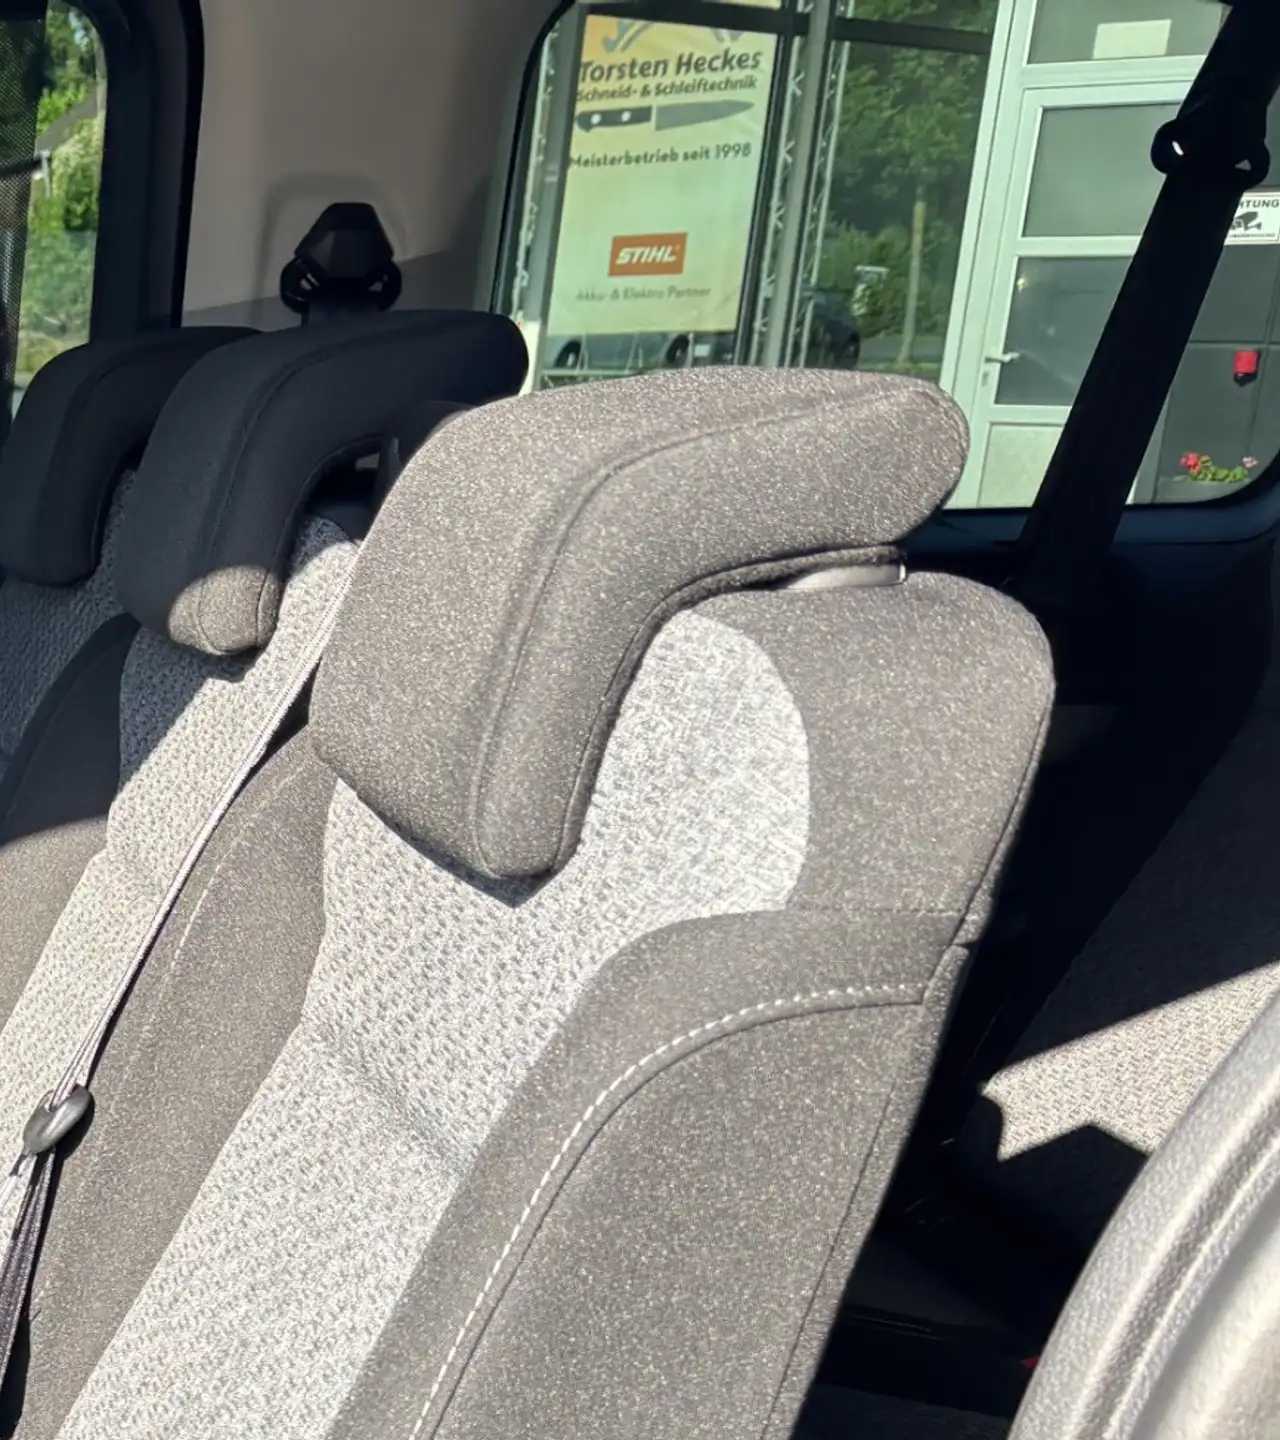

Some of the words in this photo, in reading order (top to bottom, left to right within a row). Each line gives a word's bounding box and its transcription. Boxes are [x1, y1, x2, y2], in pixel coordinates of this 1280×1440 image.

[579, 57, 669, 83] Torsten
[675, 48, 763, 80] Heckes
[640, 82, 652, 97] &
[654, 74, 758, 95] Schleiftechnik
[569, 148, 679, 168] Meisterbetrieb
[682, 146, 710, 162] seit
[715, 142, 752, 159] 1998
